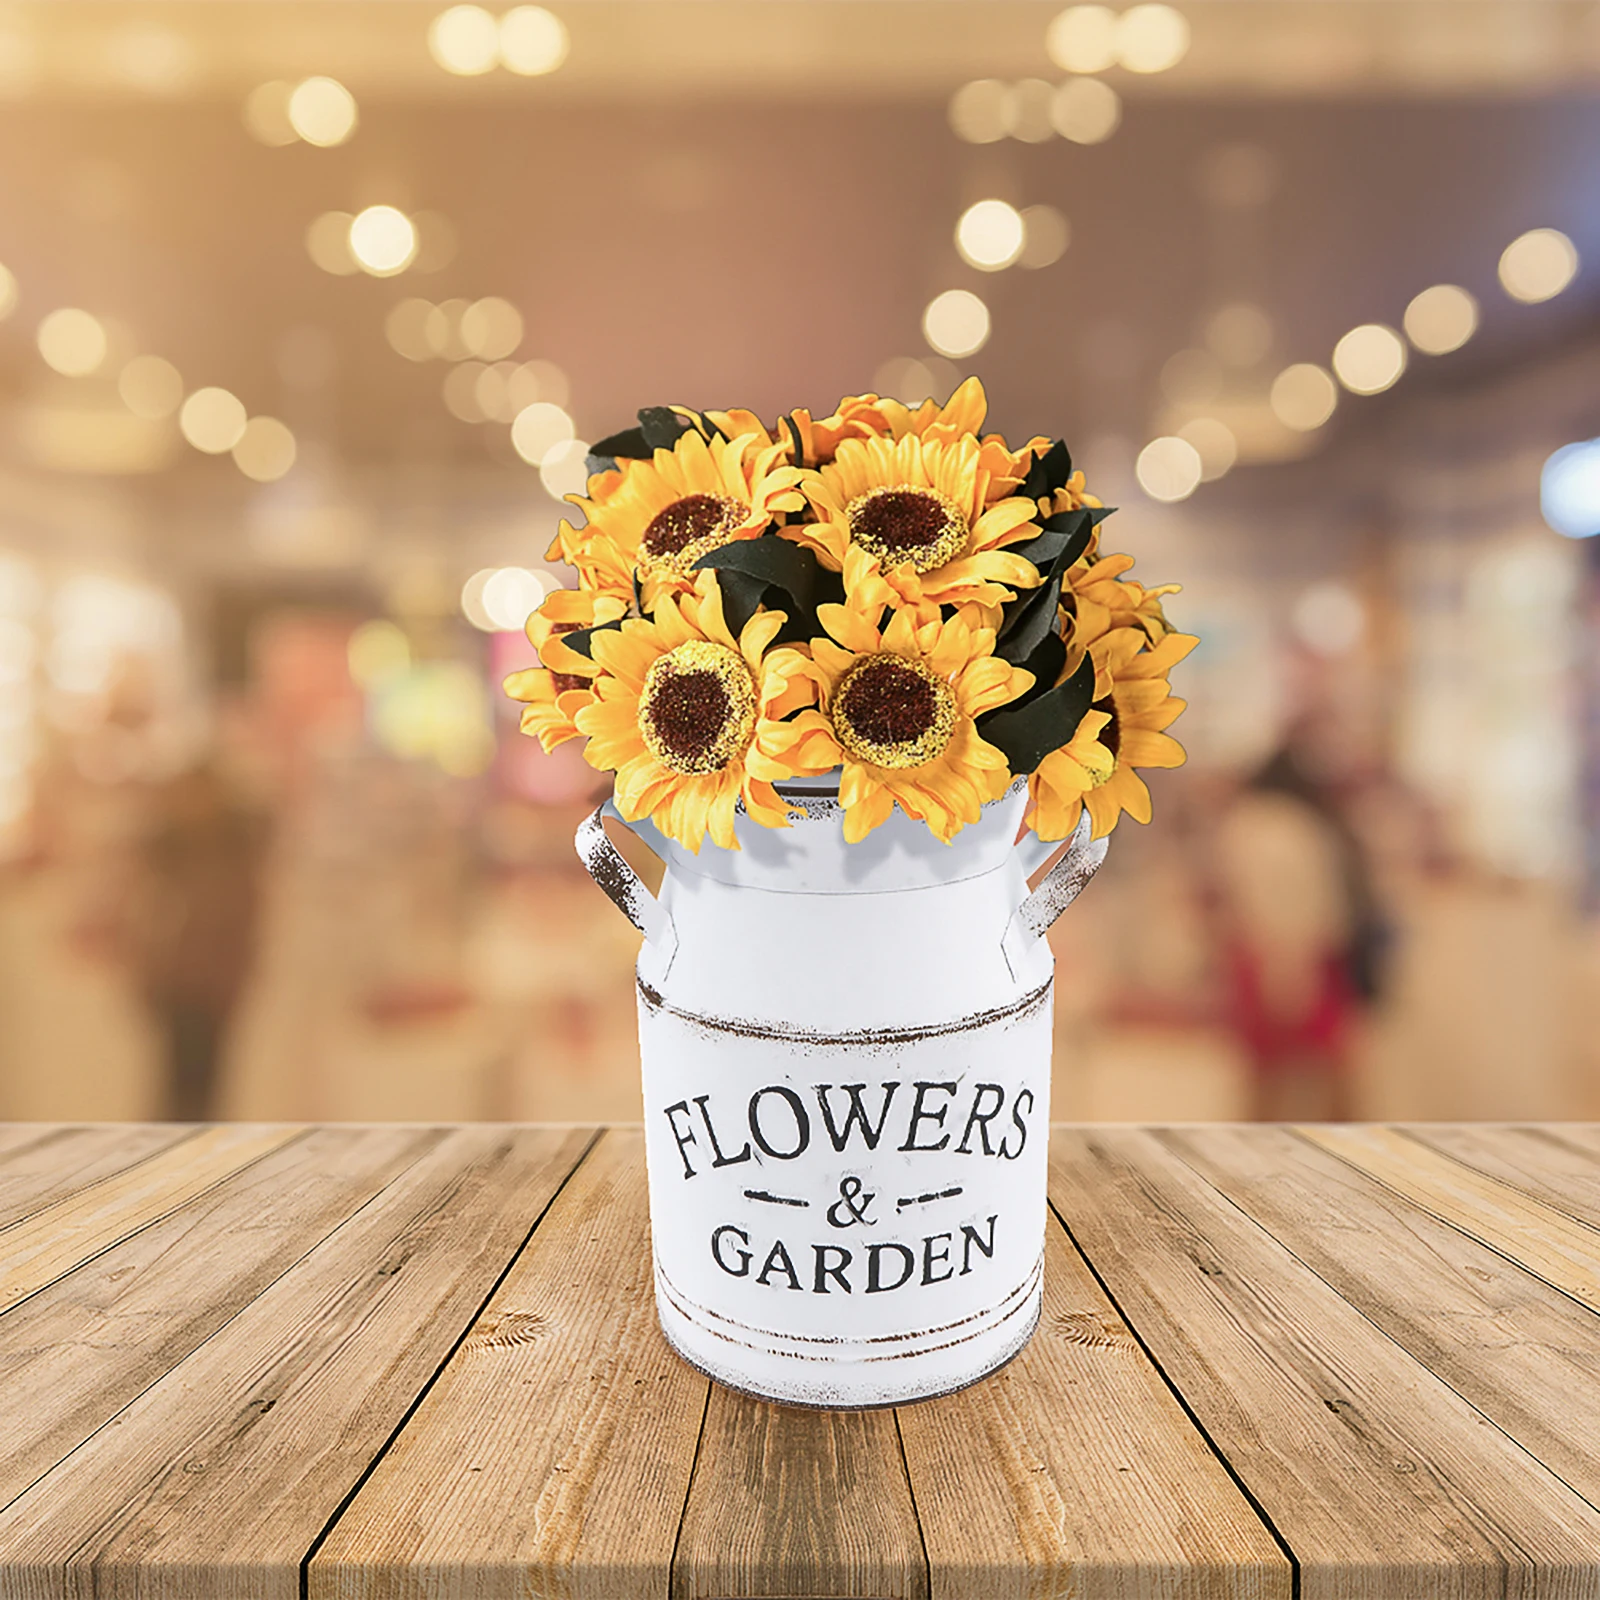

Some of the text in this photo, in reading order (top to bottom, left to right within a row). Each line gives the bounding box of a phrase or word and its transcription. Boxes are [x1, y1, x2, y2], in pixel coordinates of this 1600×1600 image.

[663, 1081, 1034, 1180] FLOWERS
[826, 1176, 877, 1228] &
[711, 1214, 999, 1295] GARDEN
